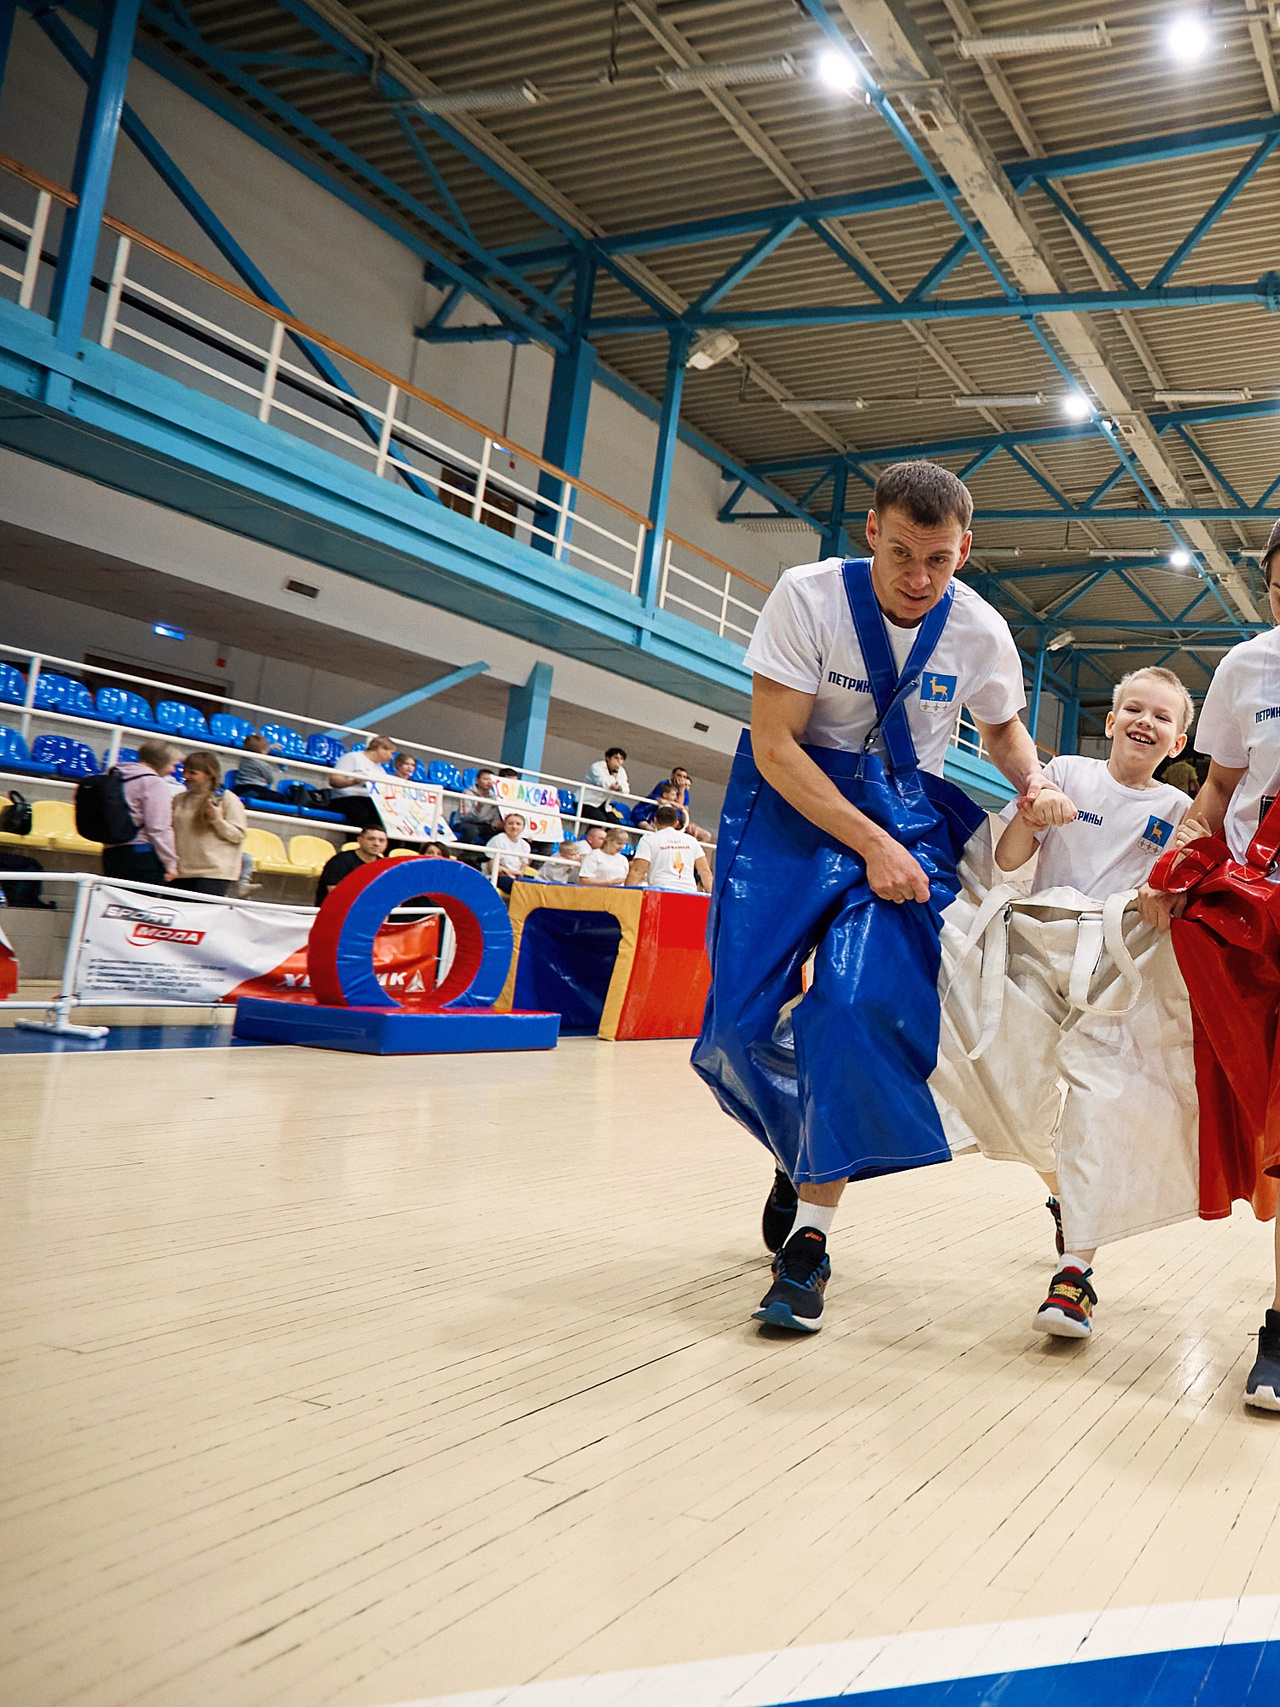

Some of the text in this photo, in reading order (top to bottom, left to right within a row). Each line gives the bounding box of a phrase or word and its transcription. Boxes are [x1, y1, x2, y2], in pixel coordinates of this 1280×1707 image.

[827, 671, 872, 693] ПЕТРИН
[1074, 810, 1104, 826] РИНЫ
[105, 906, 174, 924] SPORT
[136, 926, 200, 943] МОДА
